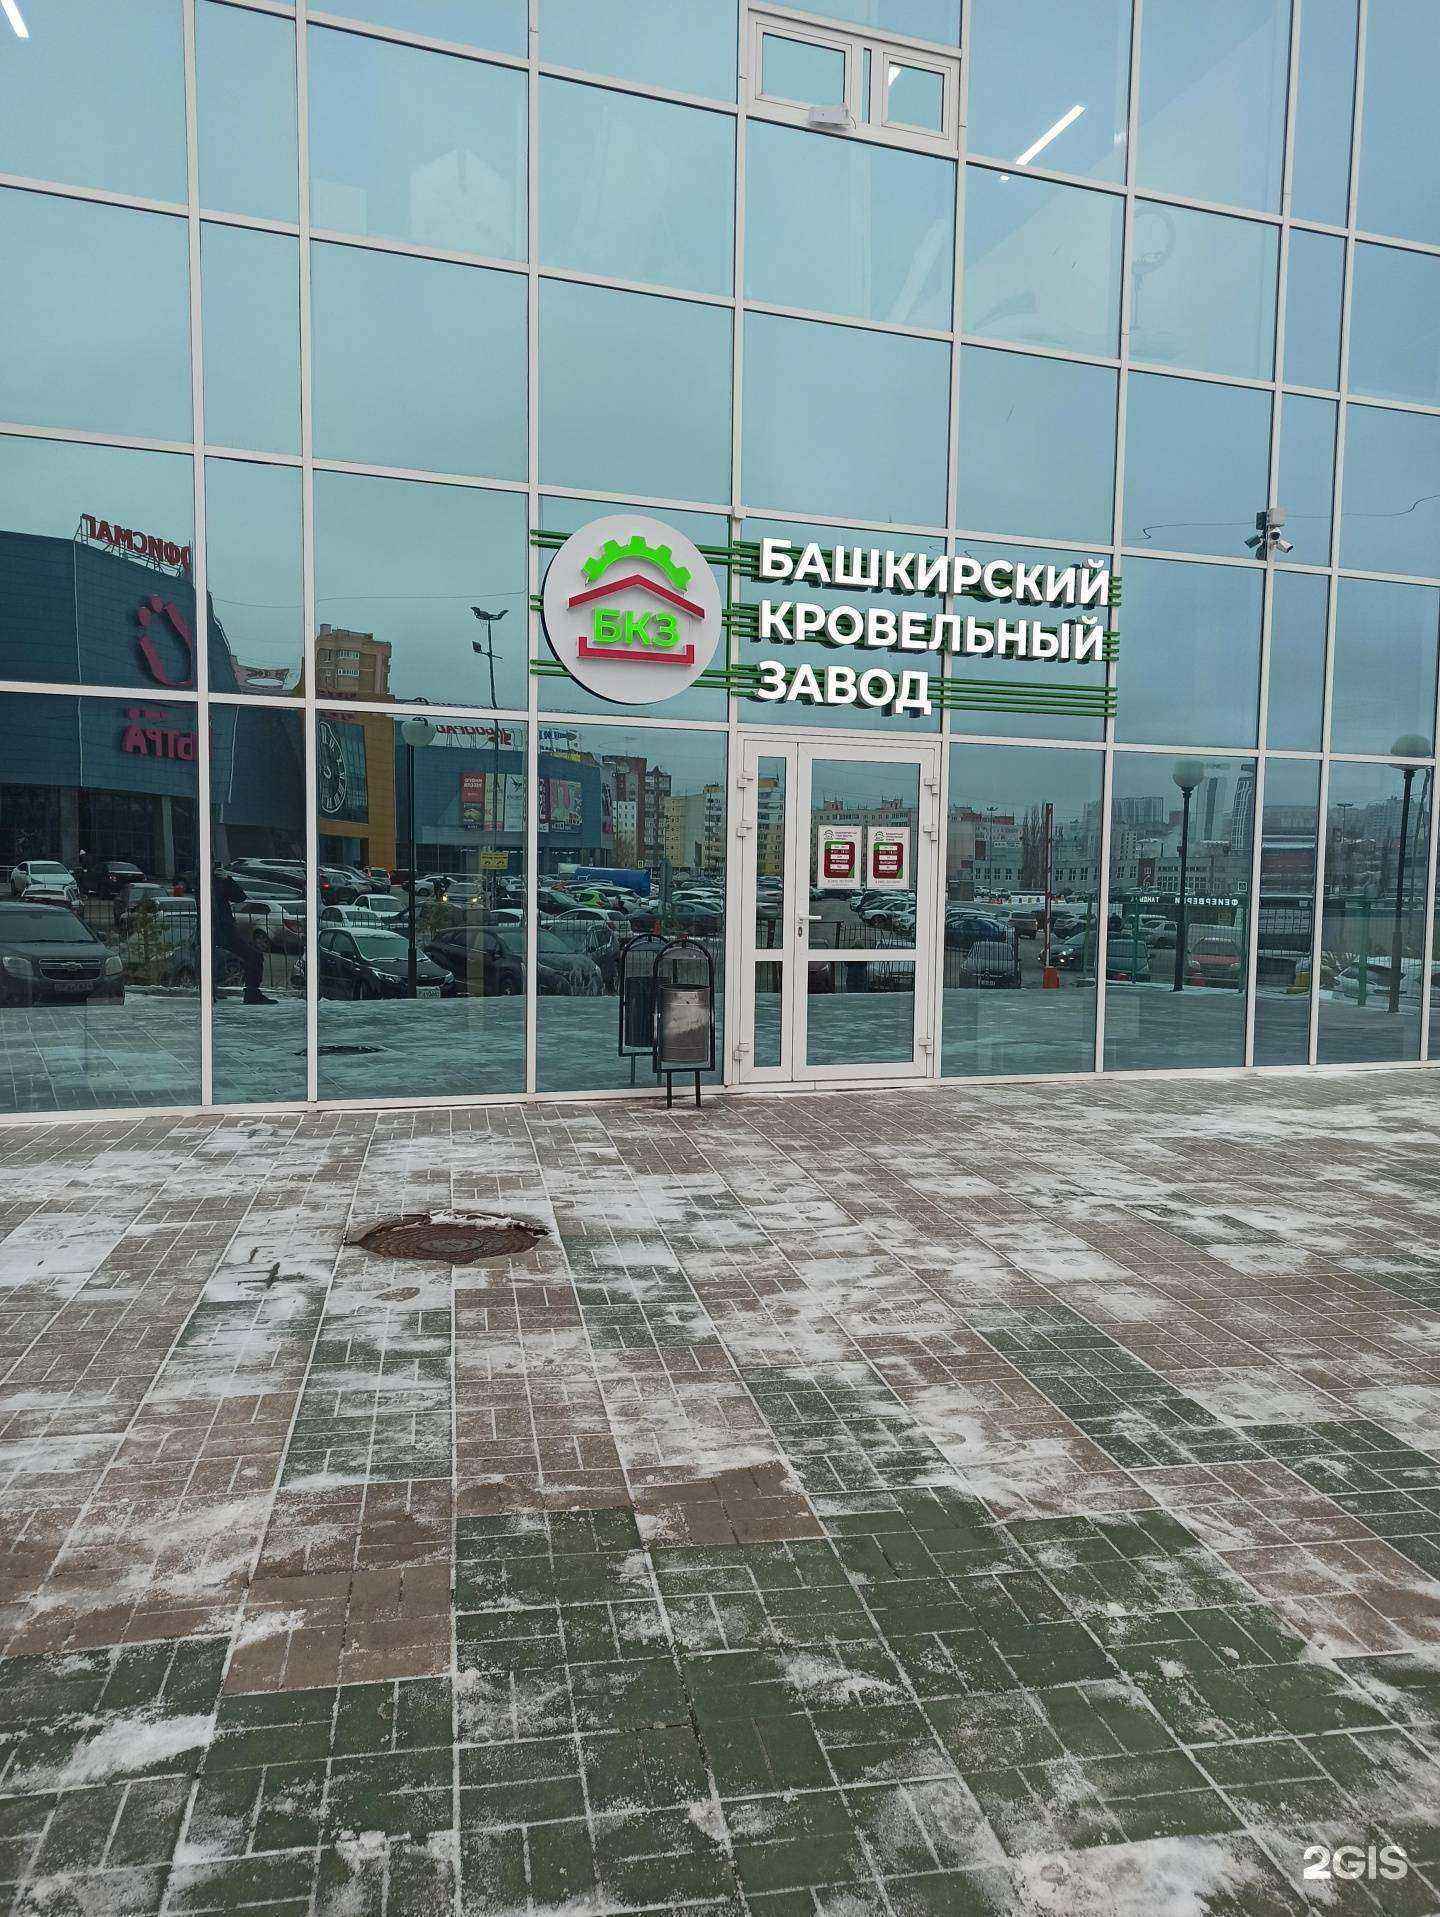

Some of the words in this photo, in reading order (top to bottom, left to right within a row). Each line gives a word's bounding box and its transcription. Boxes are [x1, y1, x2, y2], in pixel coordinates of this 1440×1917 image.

[759, 537, 1110, 606] БАШКИРСКИЙ
[593, 607, 681, 649] БКЗ
[759, 599, 1105, 662] КРОВЕЛЬНЫЙ
[757, 660, 932, 716] ЗАВОД
